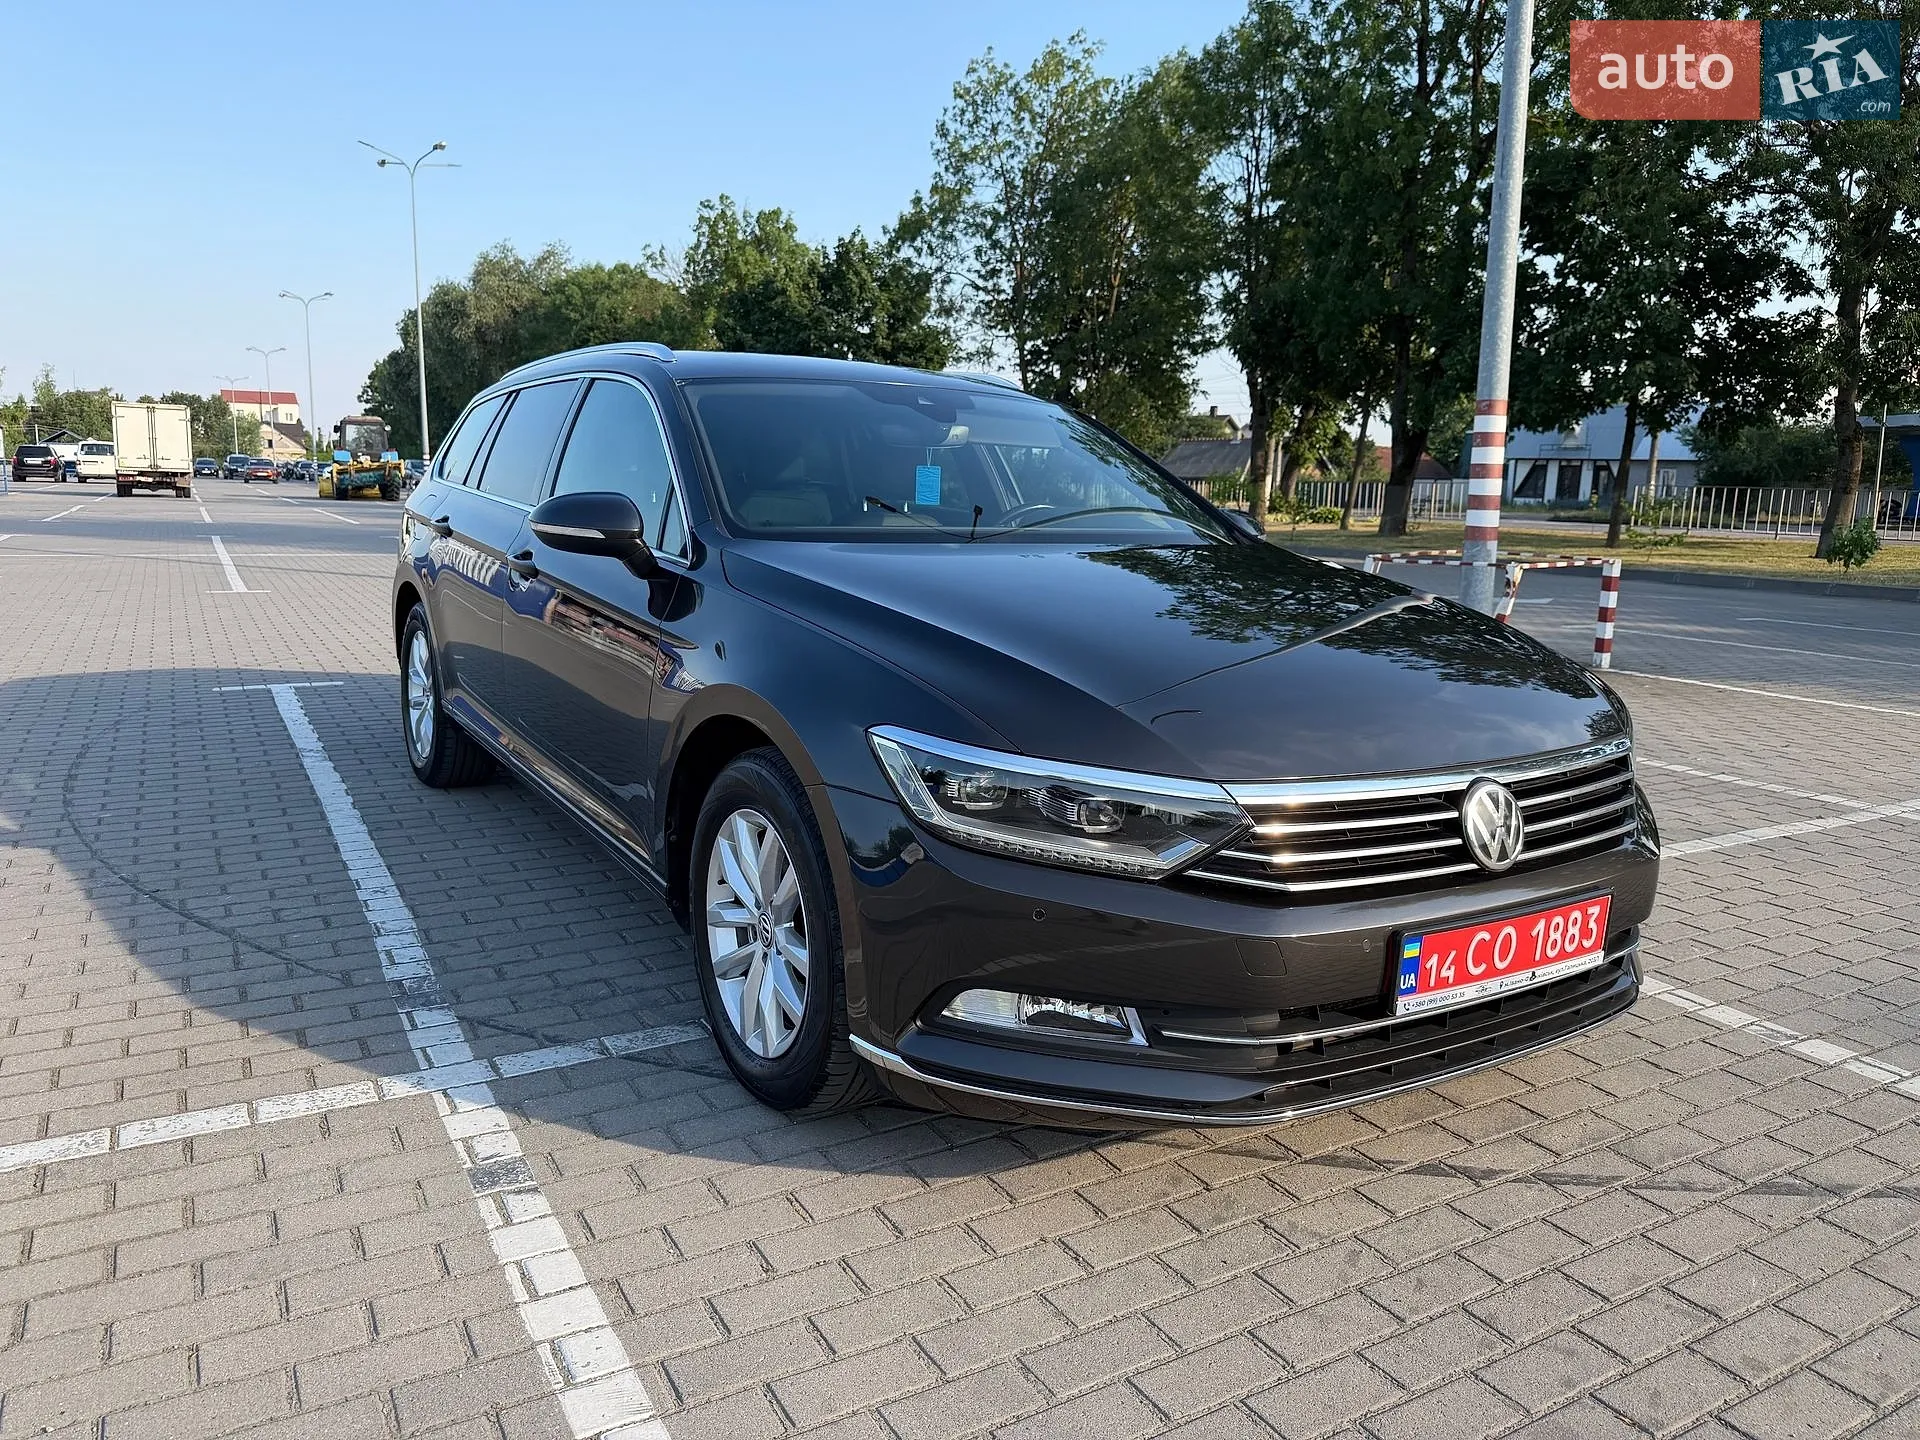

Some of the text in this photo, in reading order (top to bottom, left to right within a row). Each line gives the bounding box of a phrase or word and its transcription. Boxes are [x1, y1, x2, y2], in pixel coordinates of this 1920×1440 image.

[1424, 905, 1601, 987] 14 CO 1883
[1400, 972, 1416, 990] UA
